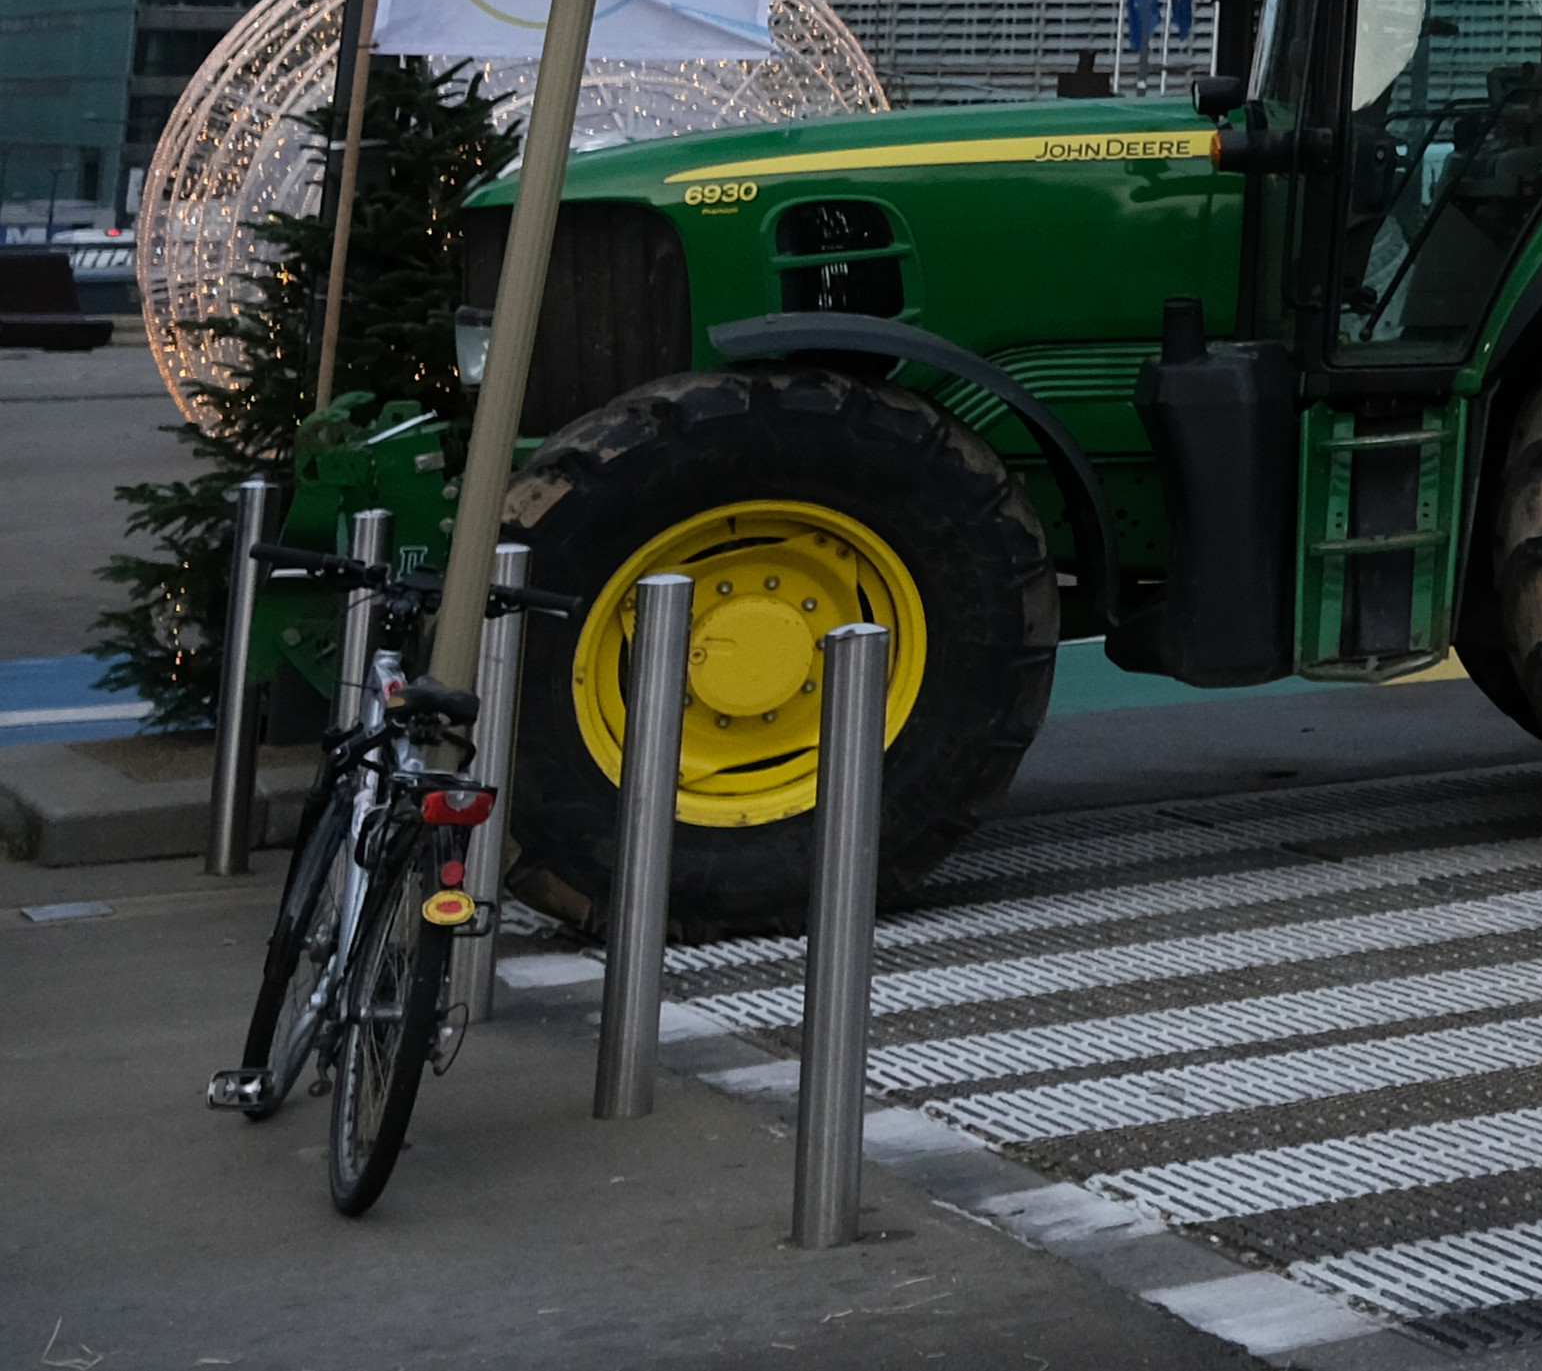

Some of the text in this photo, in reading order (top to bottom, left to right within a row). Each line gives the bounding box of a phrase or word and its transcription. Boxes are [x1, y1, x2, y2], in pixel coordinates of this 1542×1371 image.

[1035, 139, 1191, 158] JOHN DEERE
[684, 181, 758, 206] 6930
